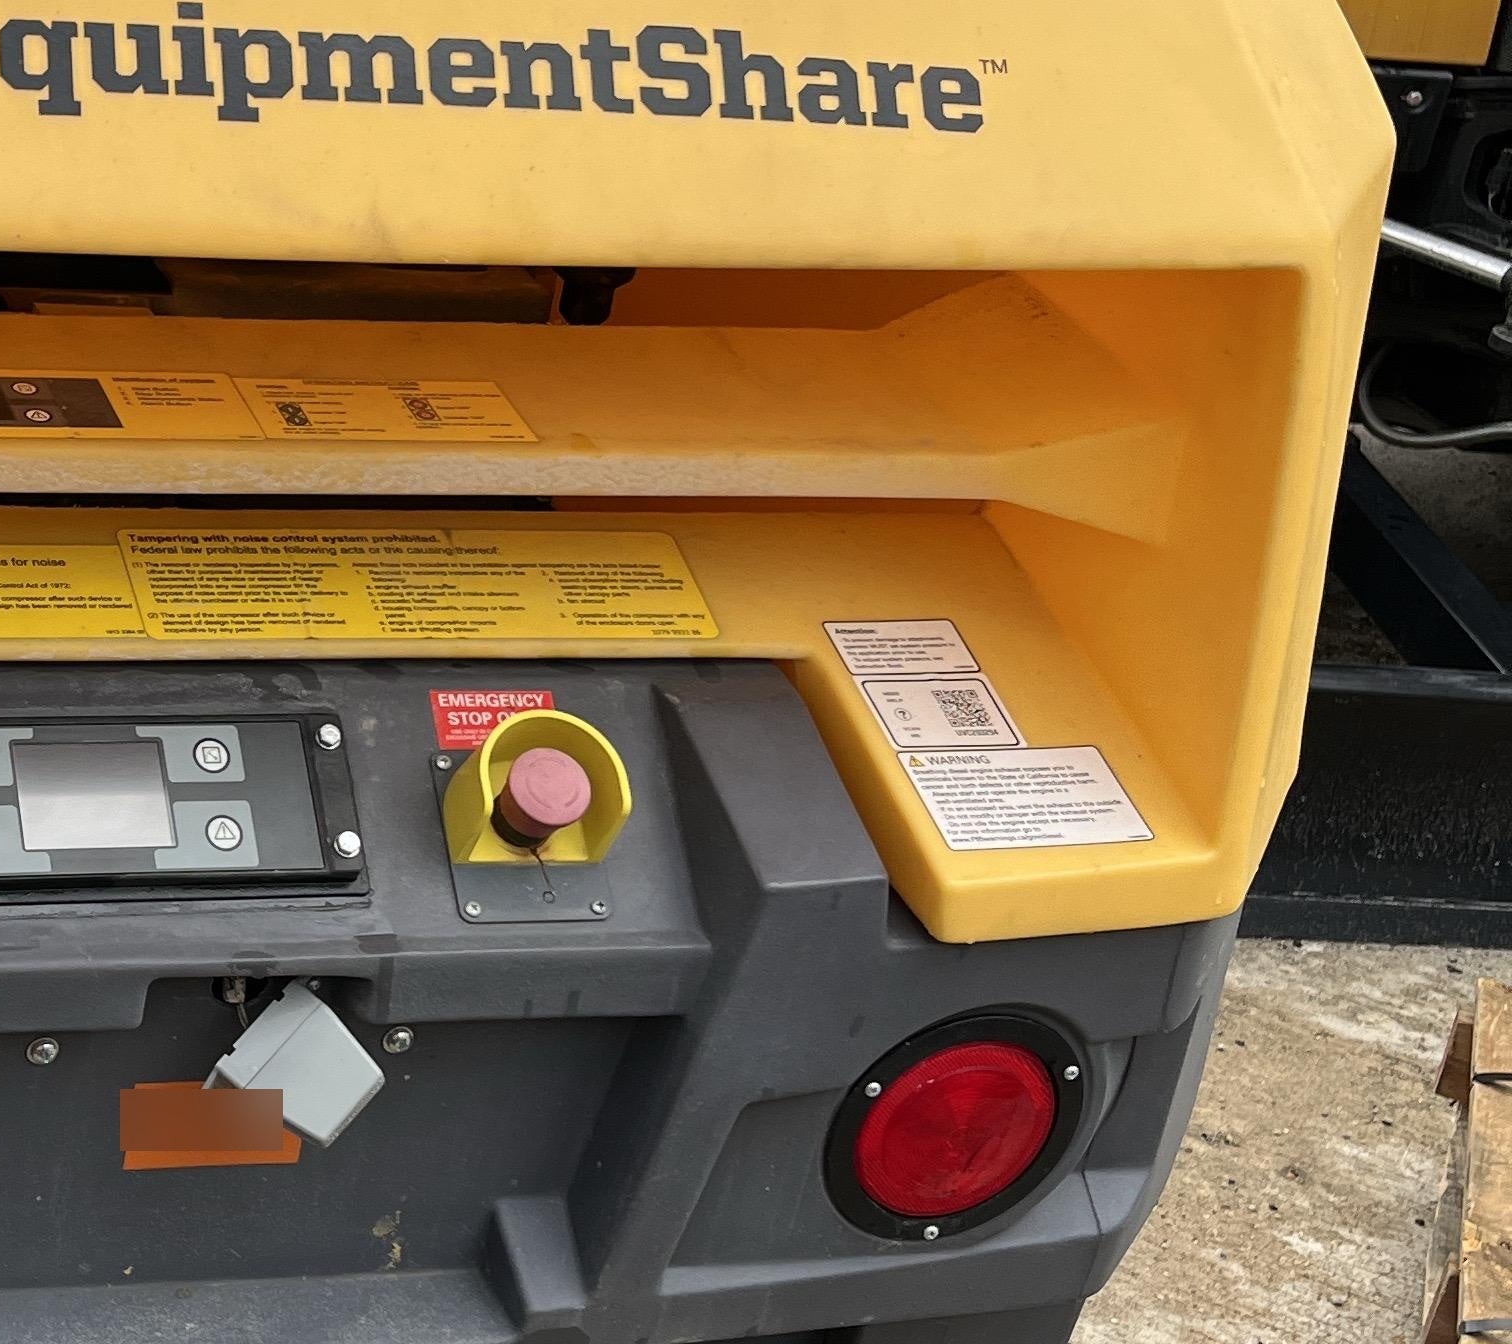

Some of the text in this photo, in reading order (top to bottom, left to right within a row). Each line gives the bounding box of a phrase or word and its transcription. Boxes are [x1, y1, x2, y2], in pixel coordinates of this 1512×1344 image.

[127, 534, 440, 544] Tampering with noise control system prohibited.
[11, 557, 27, 566] for
[33, 558, 66, 567] noise
[438, 693, 544, 707] EMERGENCY
[447, 711, 493, 725] STOP
[926, 755, 991, 764] WARNING
